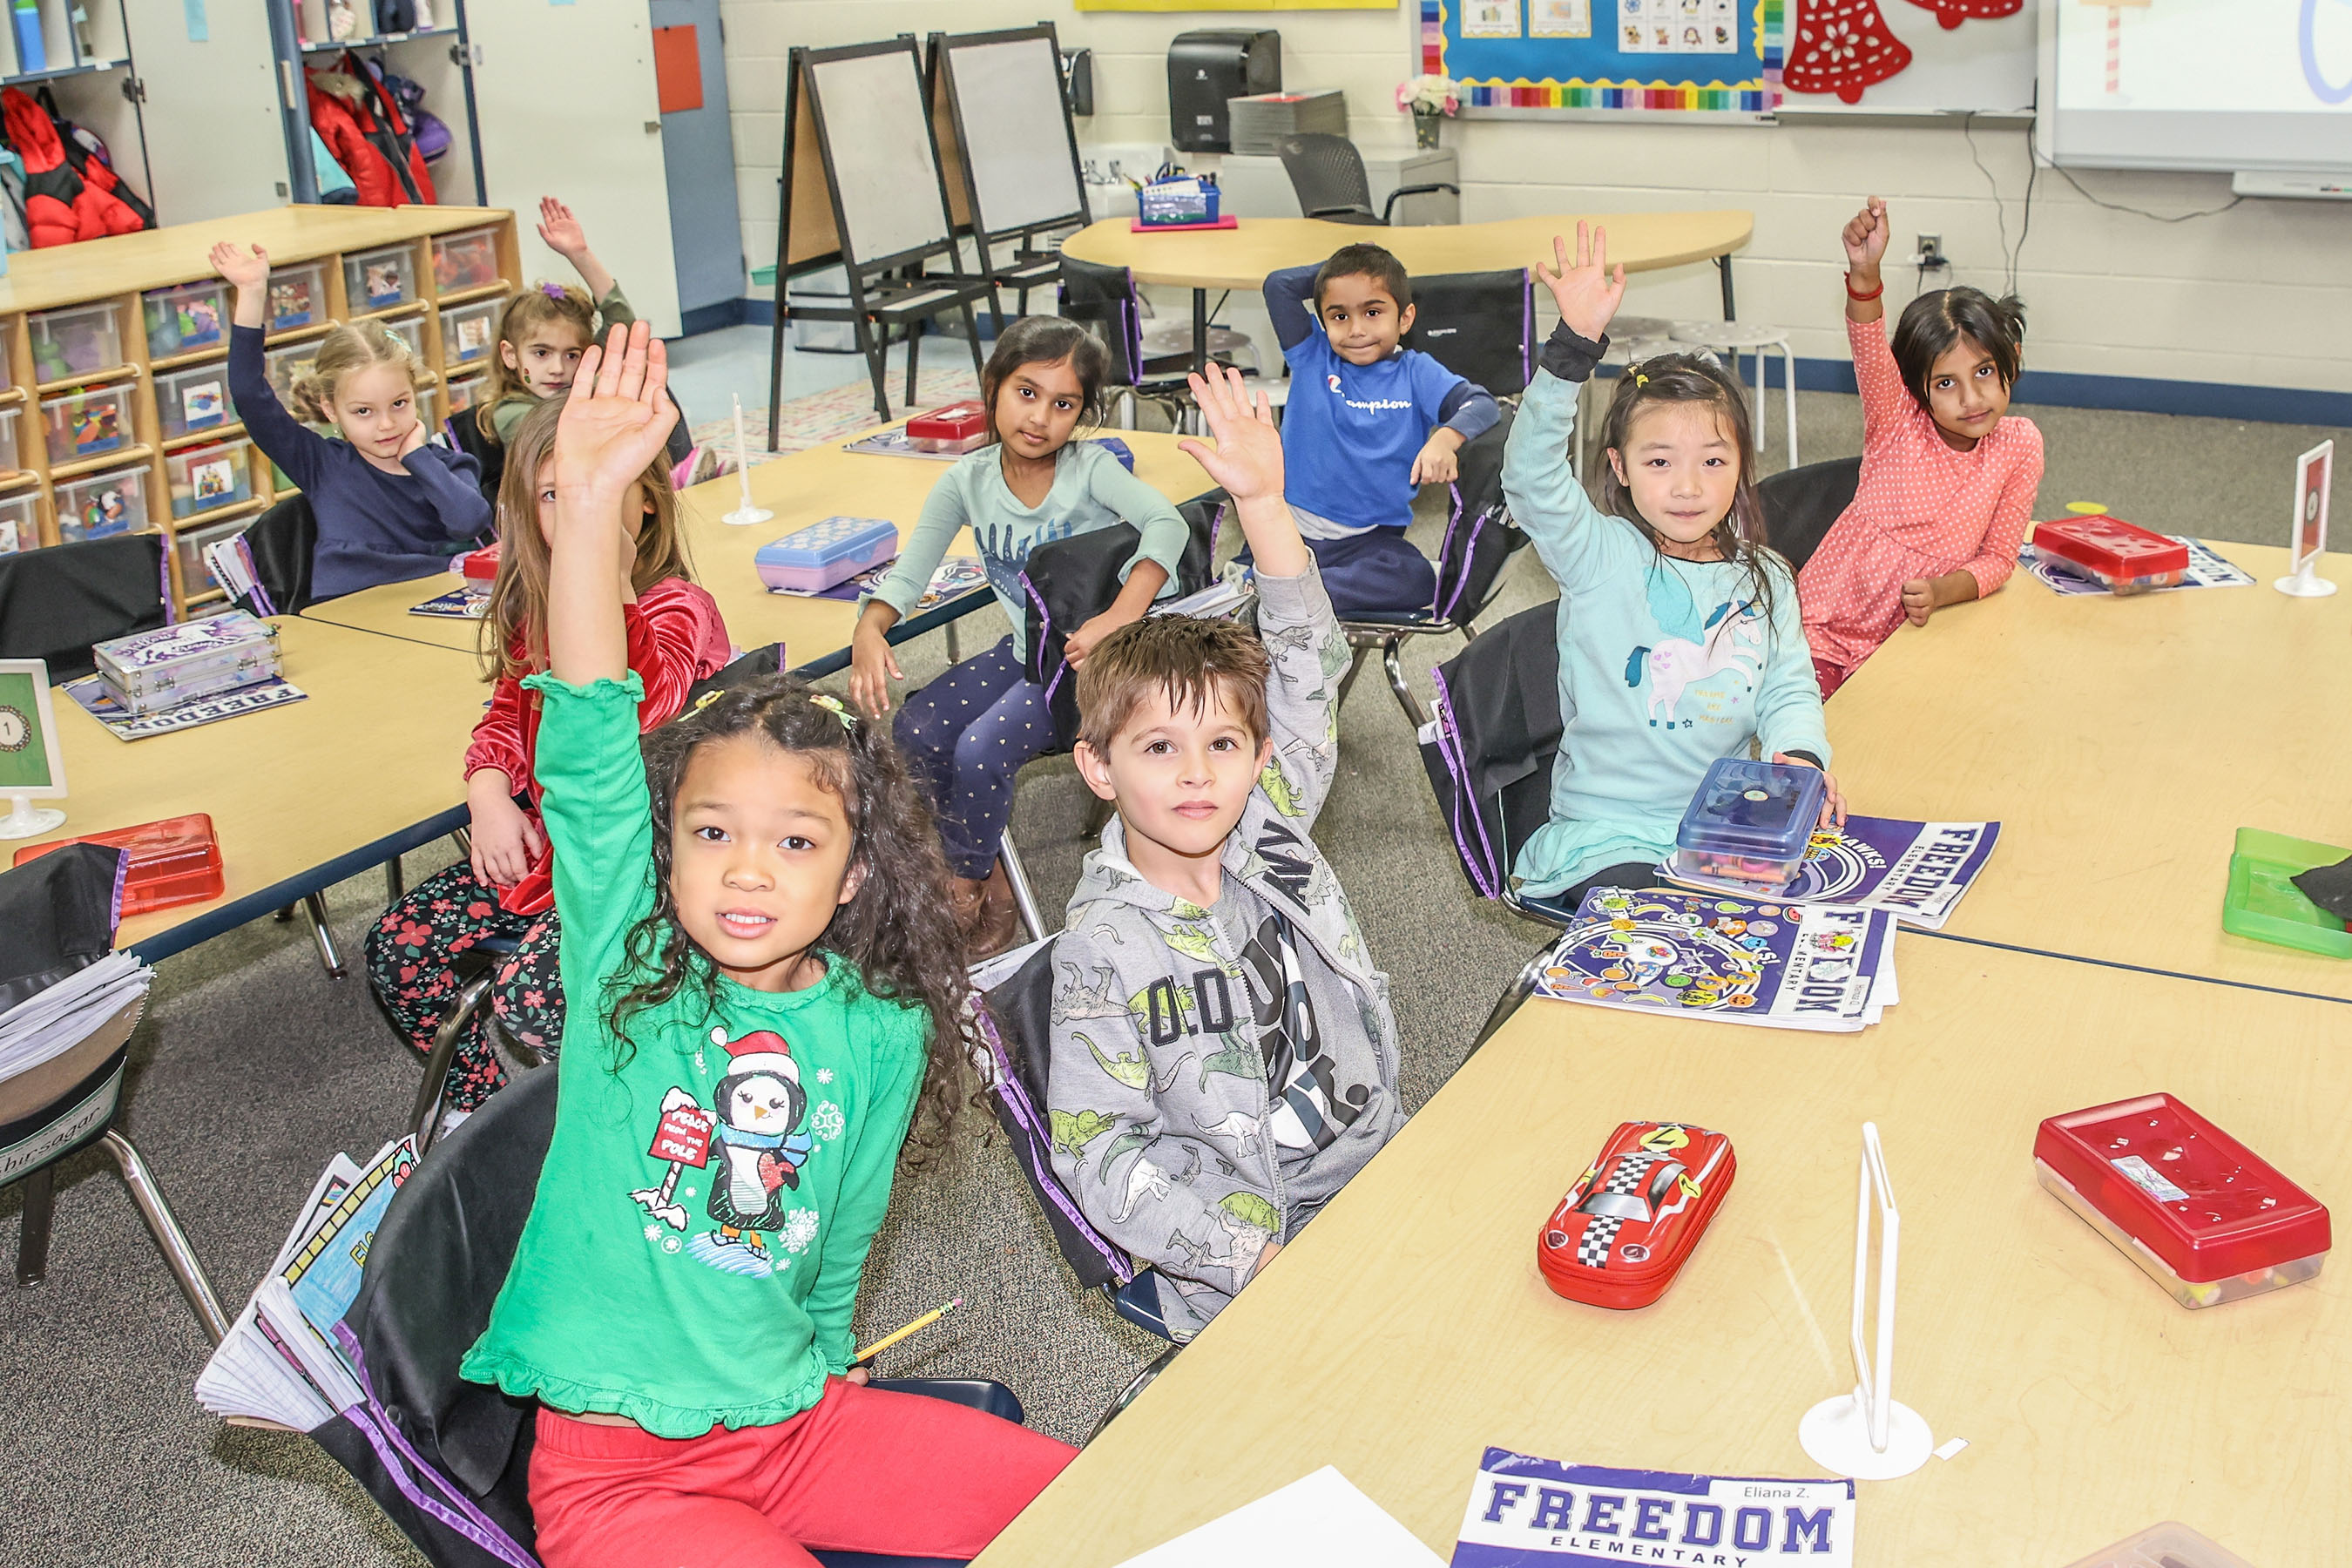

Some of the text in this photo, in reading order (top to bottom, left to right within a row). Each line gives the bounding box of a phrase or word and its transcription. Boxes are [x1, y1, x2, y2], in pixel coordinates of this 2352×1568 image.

[124, 688, 294, 731] FREEDOM
[1880, 828, 1980, 909] FREEDOM
[1881, 845, 1926, 892] ELEMENTARY
[0, 1106, 100, 1173] hirsagar
[663, 1123, 704, 1148] FROM THE
[671, 1110, 709, 1133] PEACE
[660, 1139, 699, 1161] POLE
[1744, 1486, 1809, 1498] Eliana Z.
[1482, 1480, 1835, 1554] FREEDOM
[1551, 1536, 1748, 1568] ELEMENTARY
